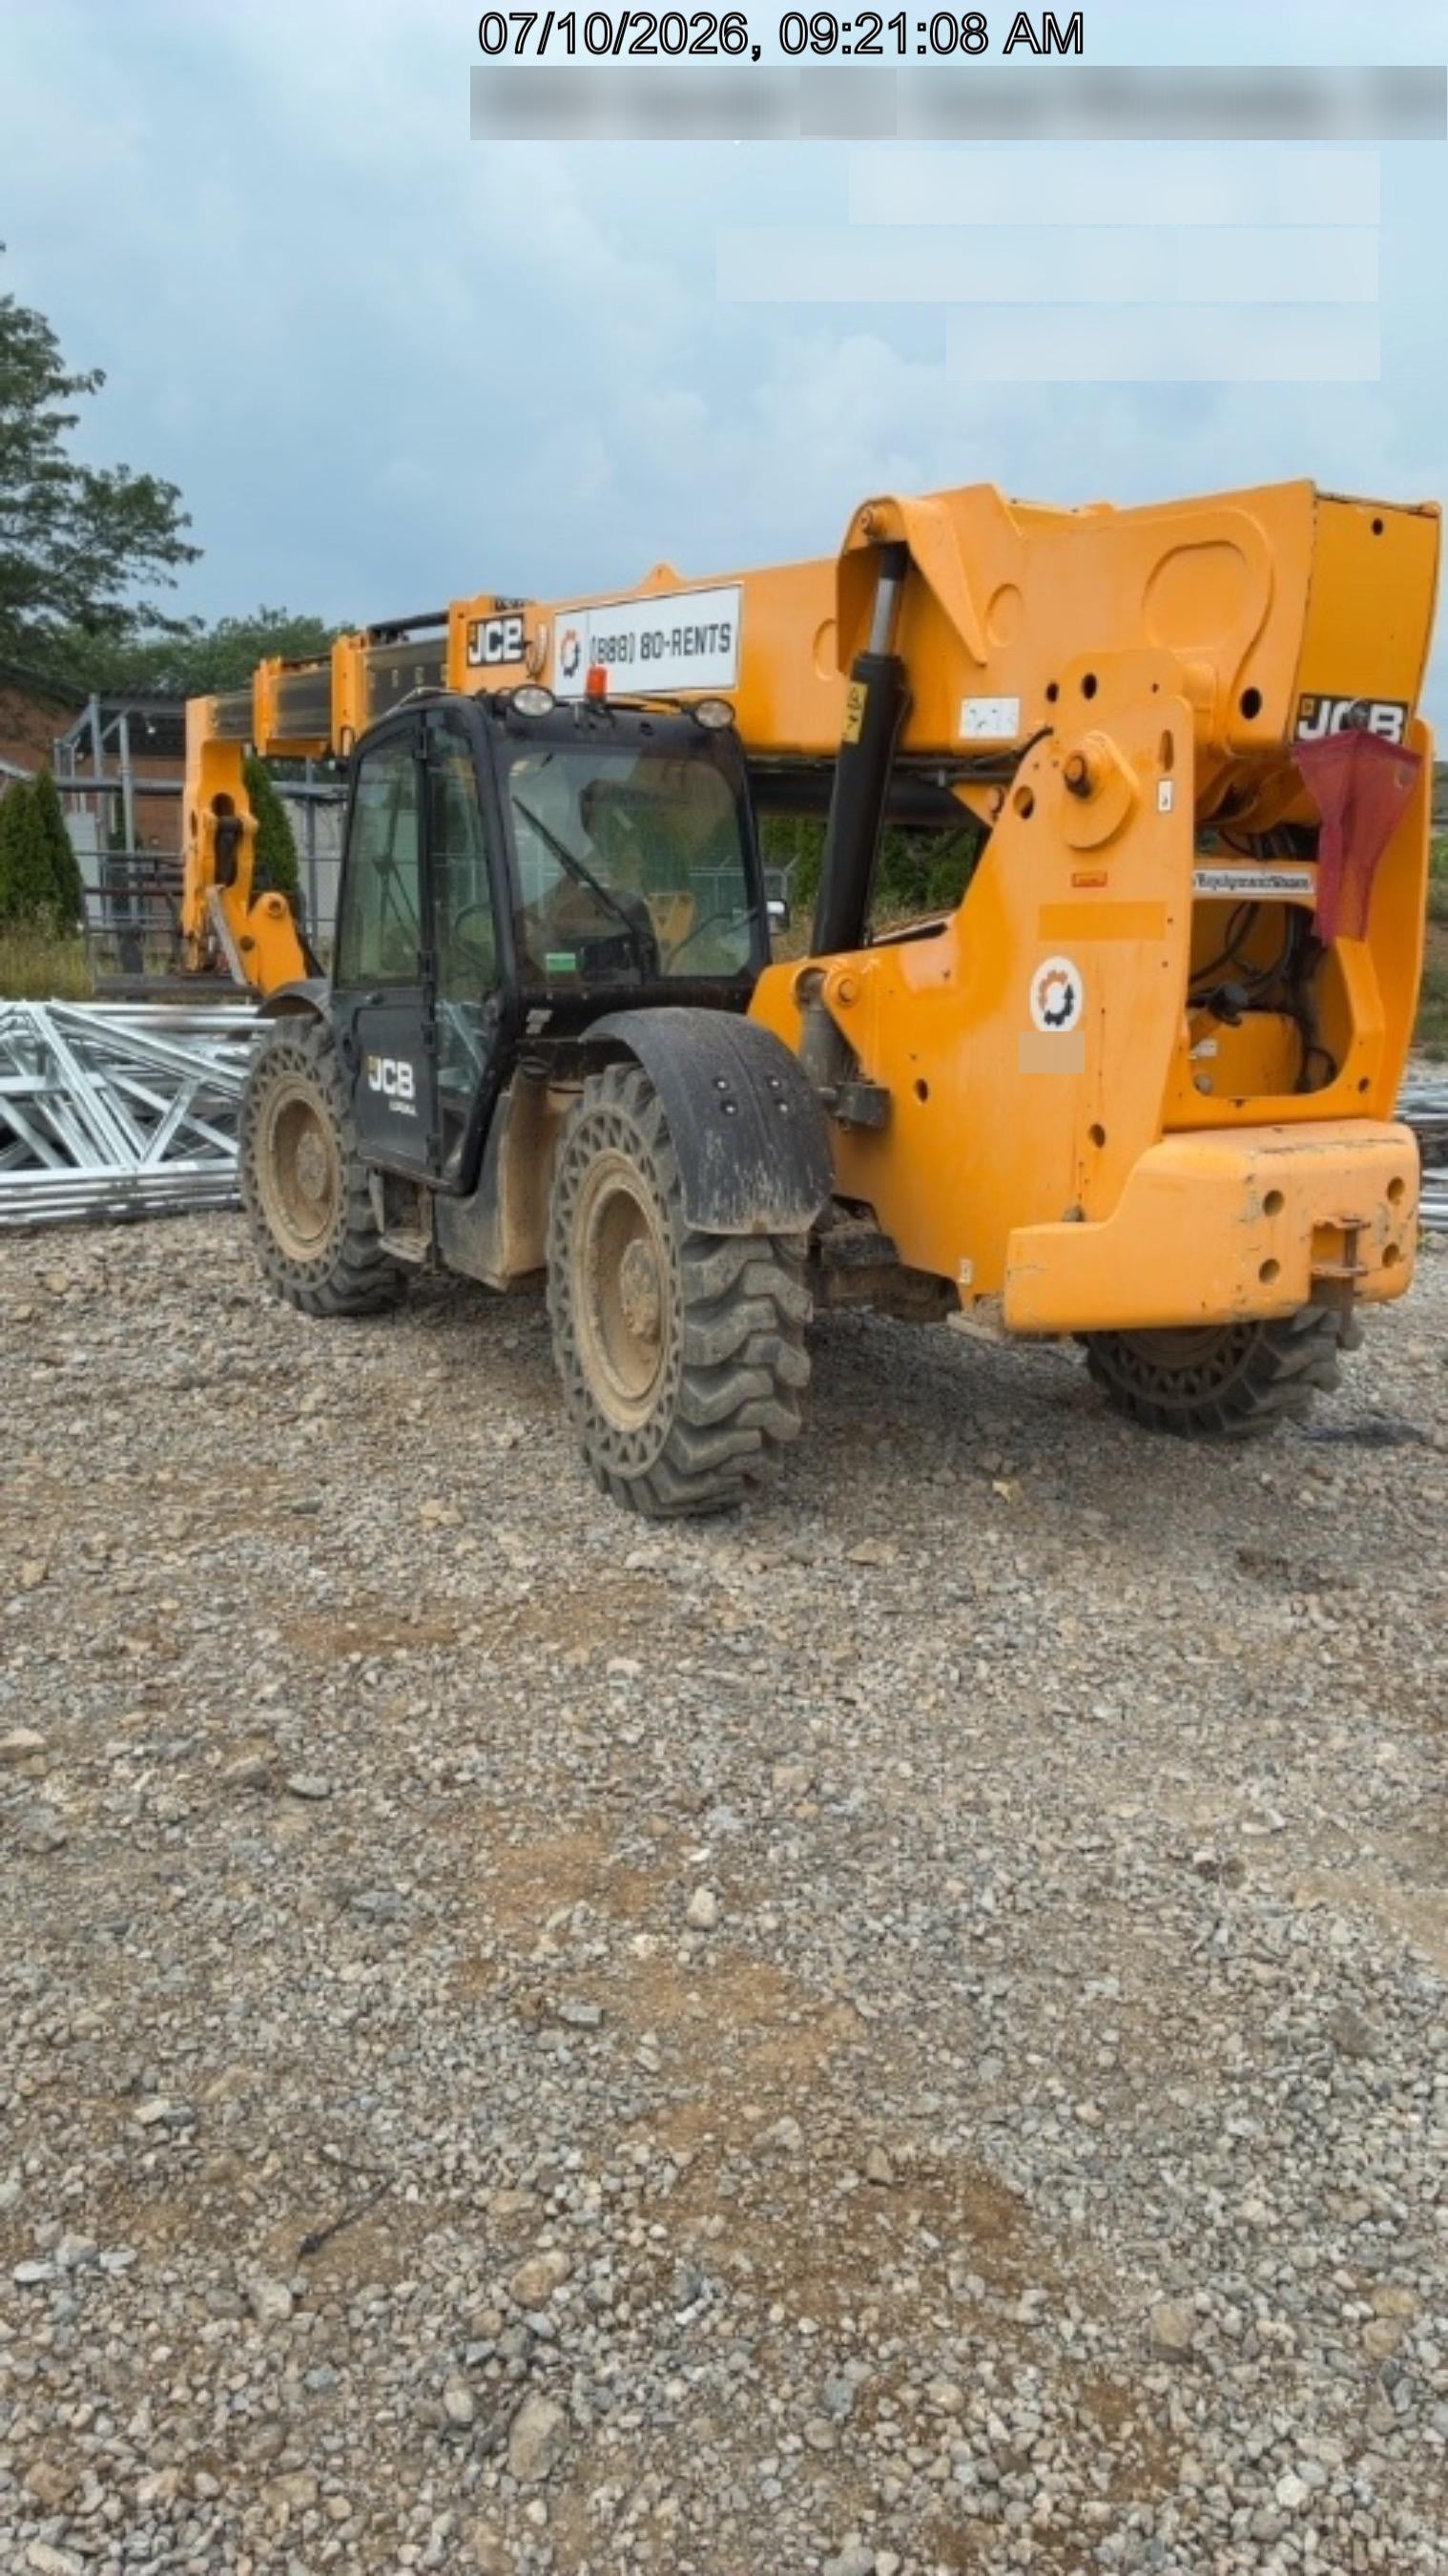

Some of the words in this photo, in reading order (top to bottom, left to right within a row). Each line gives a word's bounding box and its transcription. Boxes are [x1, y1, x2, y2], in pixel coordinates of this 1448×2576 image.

[468, 616, 524, 665] JCB
[640, 623, 732, 660] 80-RENTS
[367, 1055, 416, 1100] JCB
